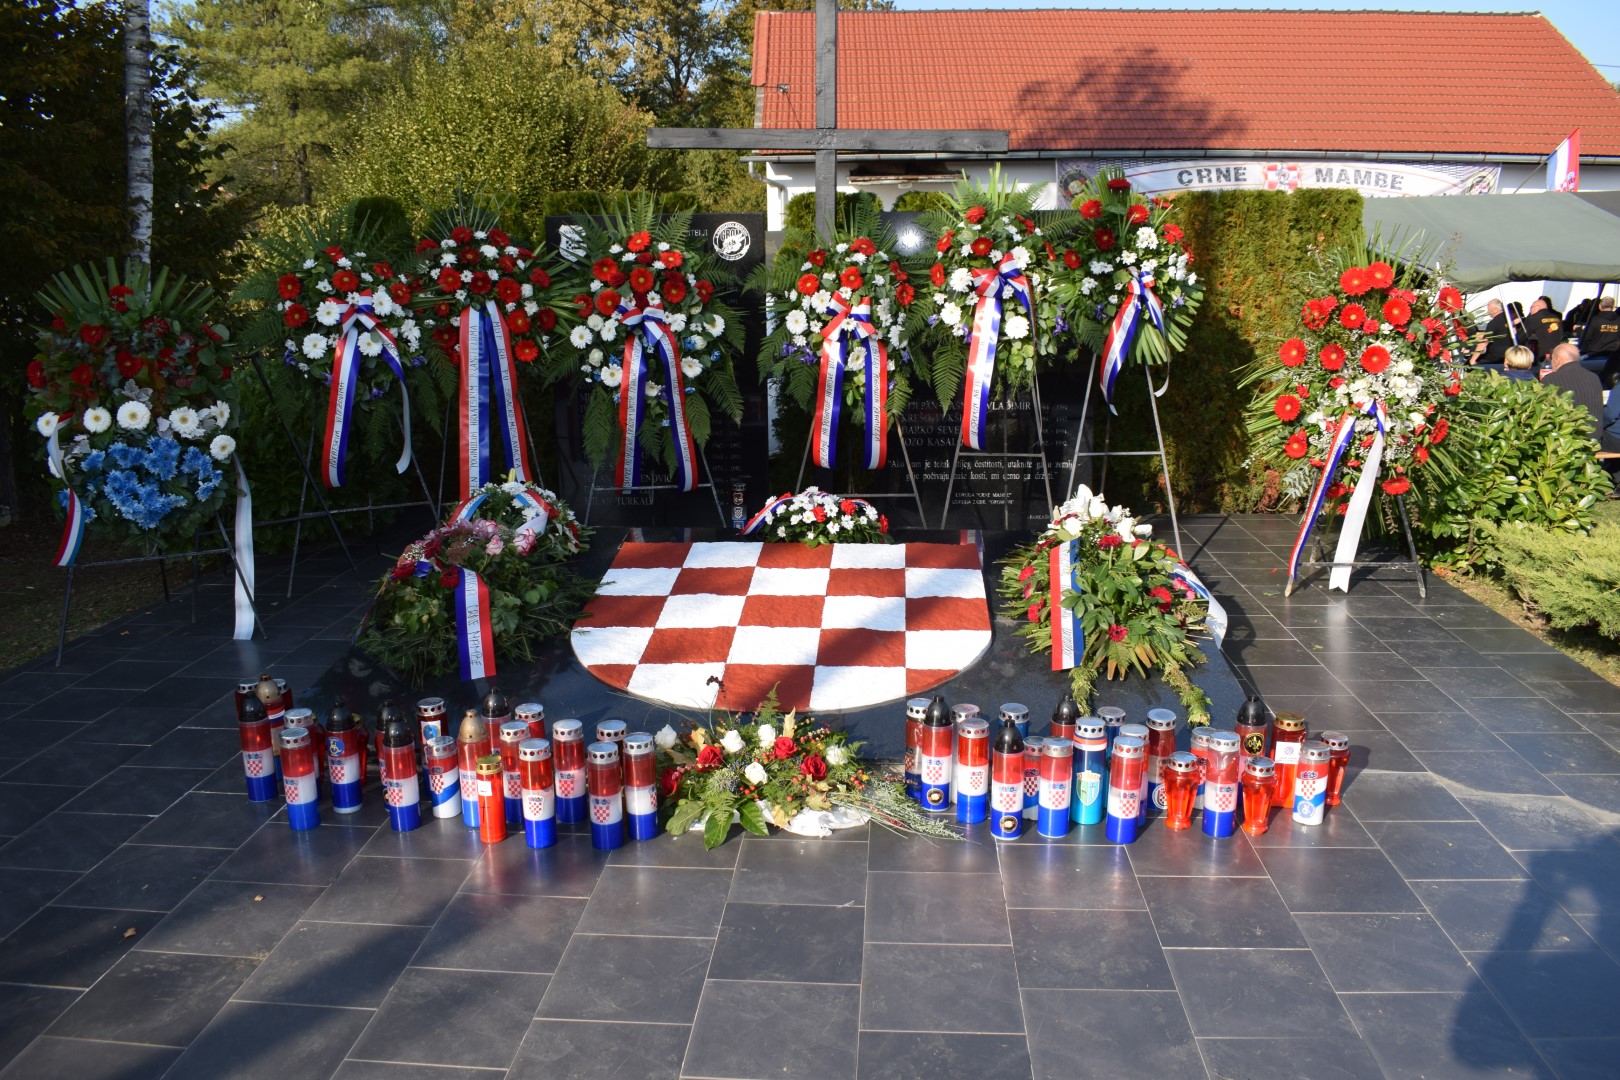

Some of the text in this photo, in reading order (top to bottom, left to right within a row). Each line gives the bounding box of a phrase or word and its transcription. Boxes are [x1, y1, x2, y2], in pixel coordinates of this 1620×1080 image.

[1177, 166, 1405, 190] CRNE MAMBE
[498, 348, 505, 359] RH
[469, 385, 477, 426] HRVATSKIM
[935, 412, 962, 422] VUKŠI
[937, 426, 960, 434] SEVE
[904, 437, 923, 446] OZO
[329, 430, 340, 468] HRVATSKIM
[925, 459, 931, 470] je
[1007, 459, 1032, 468] utaknite
[1055, 459, 1075, 470] zemlj
[906, 473, 919, 482] gje
[970, 471, 988, 481] kosti,
[991, 472, 999, 480] mi
